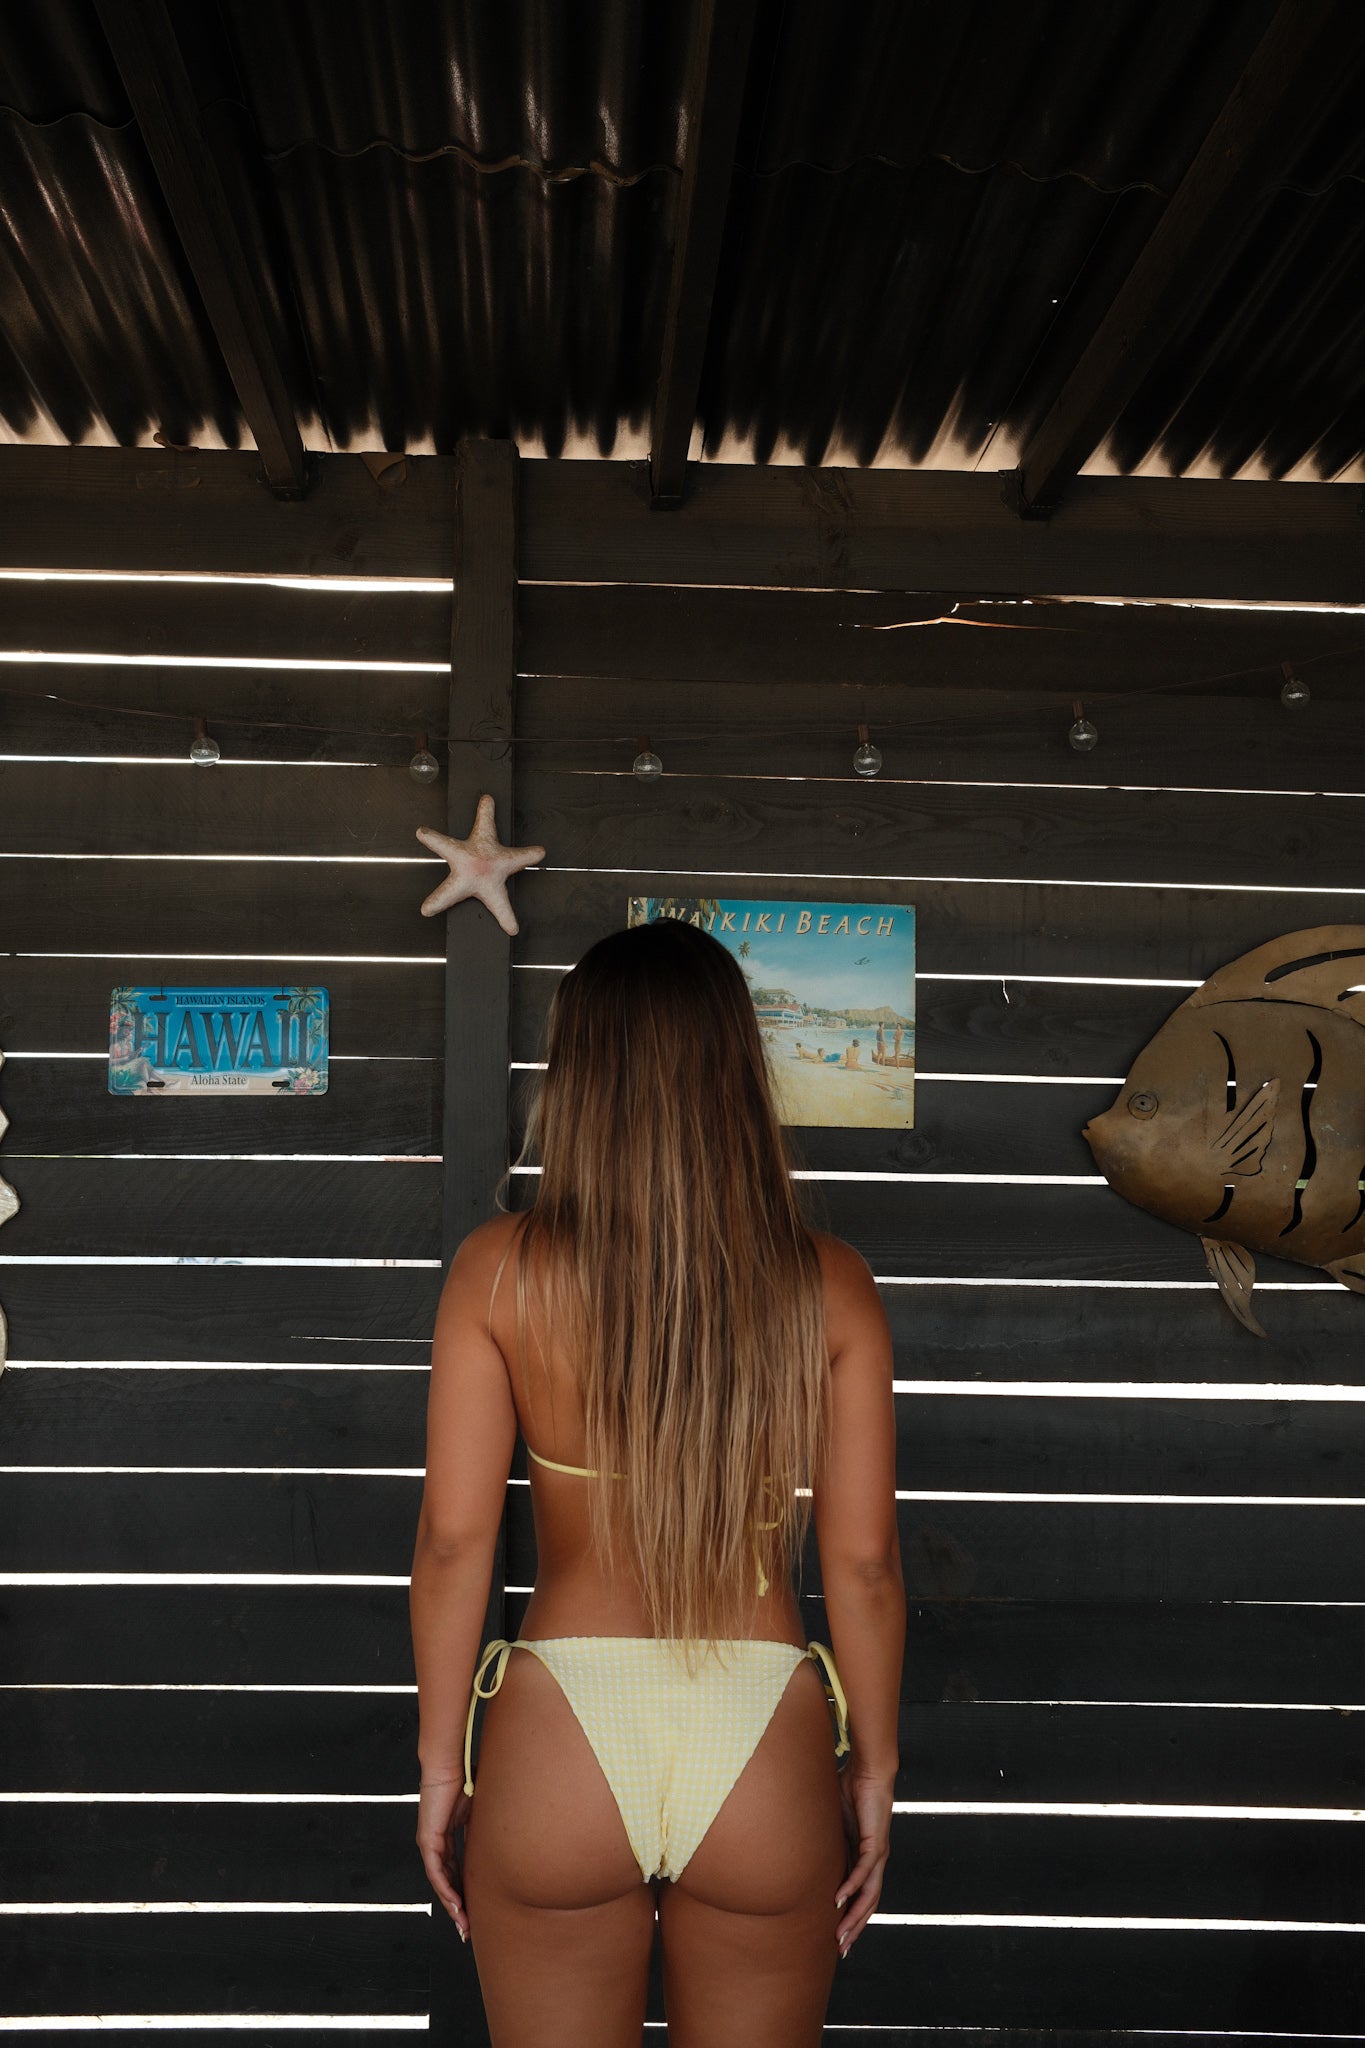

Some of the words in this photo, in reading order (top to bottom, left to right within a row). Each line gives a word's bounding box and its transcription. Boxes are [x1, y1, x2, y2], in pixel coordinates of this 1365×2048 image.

[796, 910, 895, 936] BEACH
[176, 995, 225, 1005] HAWAIIAN
[227, 995, 265, 1005] ISLANDS
[134, 1010, 313, 1070] HAWAII
[191, 1074, 220, 1085] Aloha
[222, 1074, 247, 1085] State
